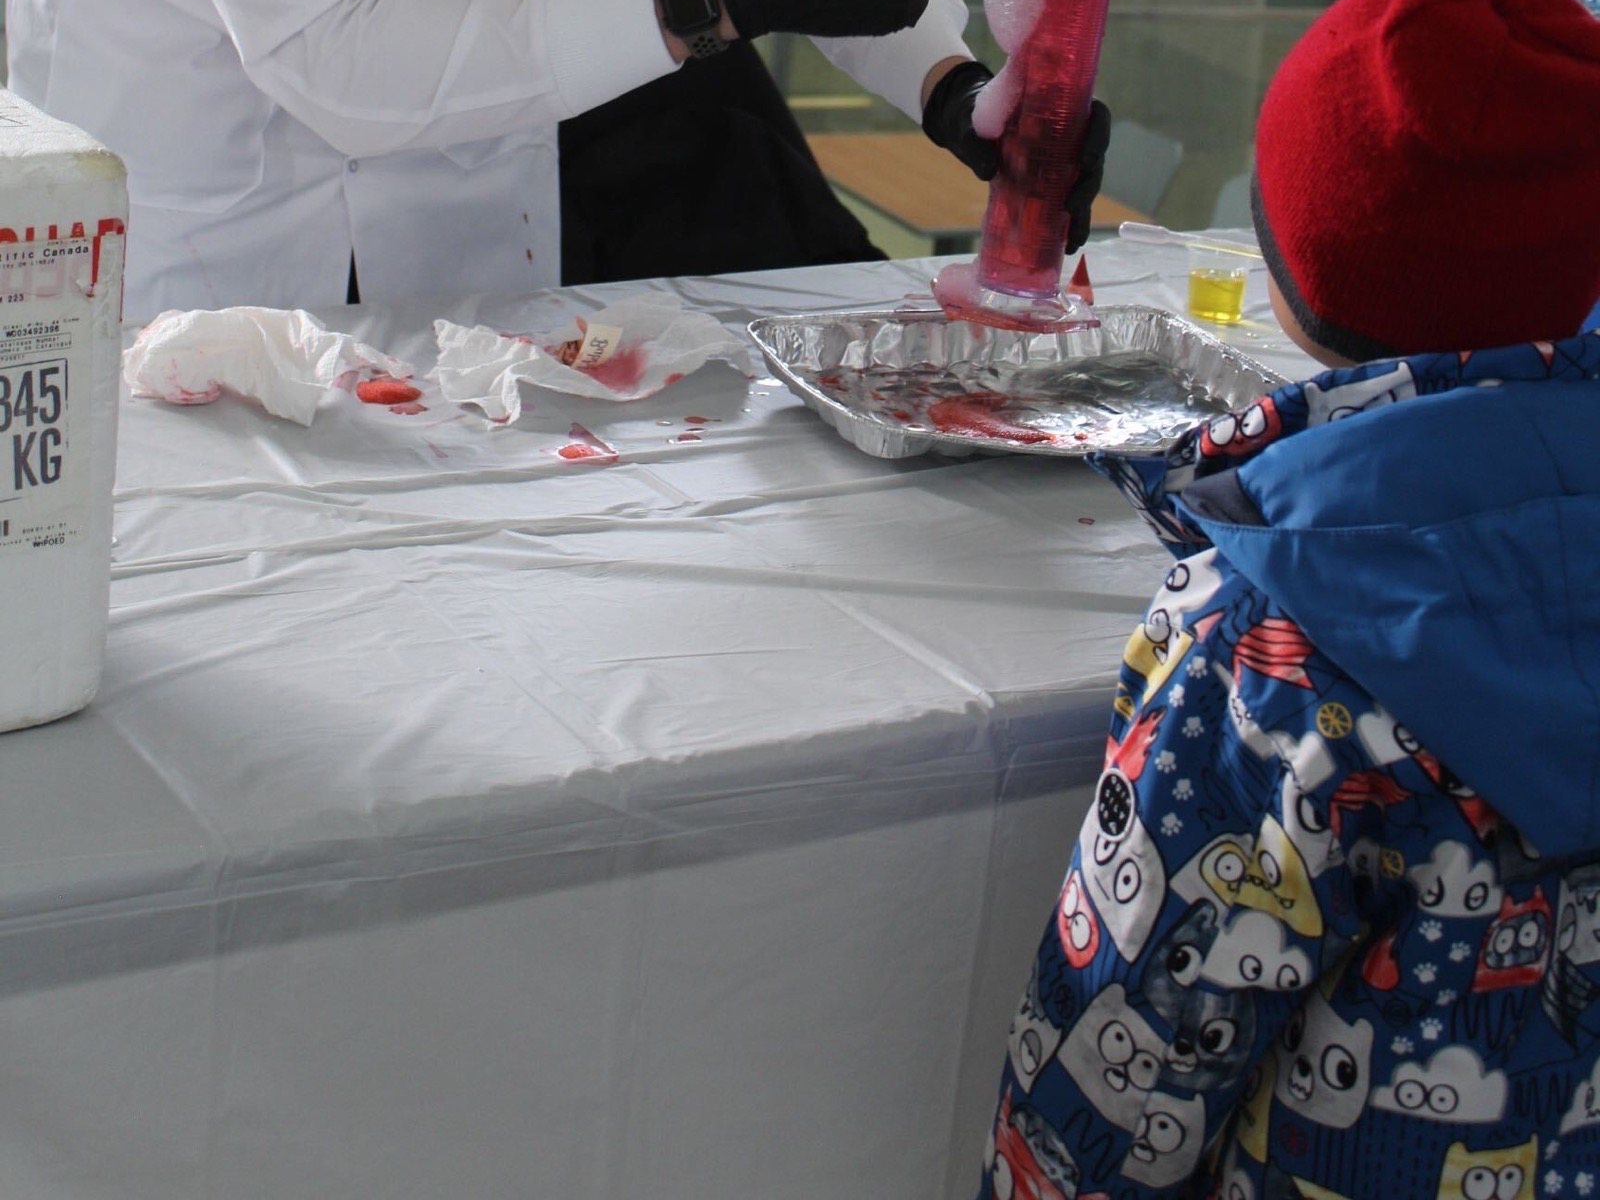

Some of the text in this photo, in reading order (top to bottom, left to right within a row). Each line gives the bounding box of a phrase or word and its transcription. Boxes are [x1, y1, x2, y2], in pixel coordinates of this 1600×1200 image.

[0, 245, 89, 262] ific Canada
[13, 427, 62, 491] KG
